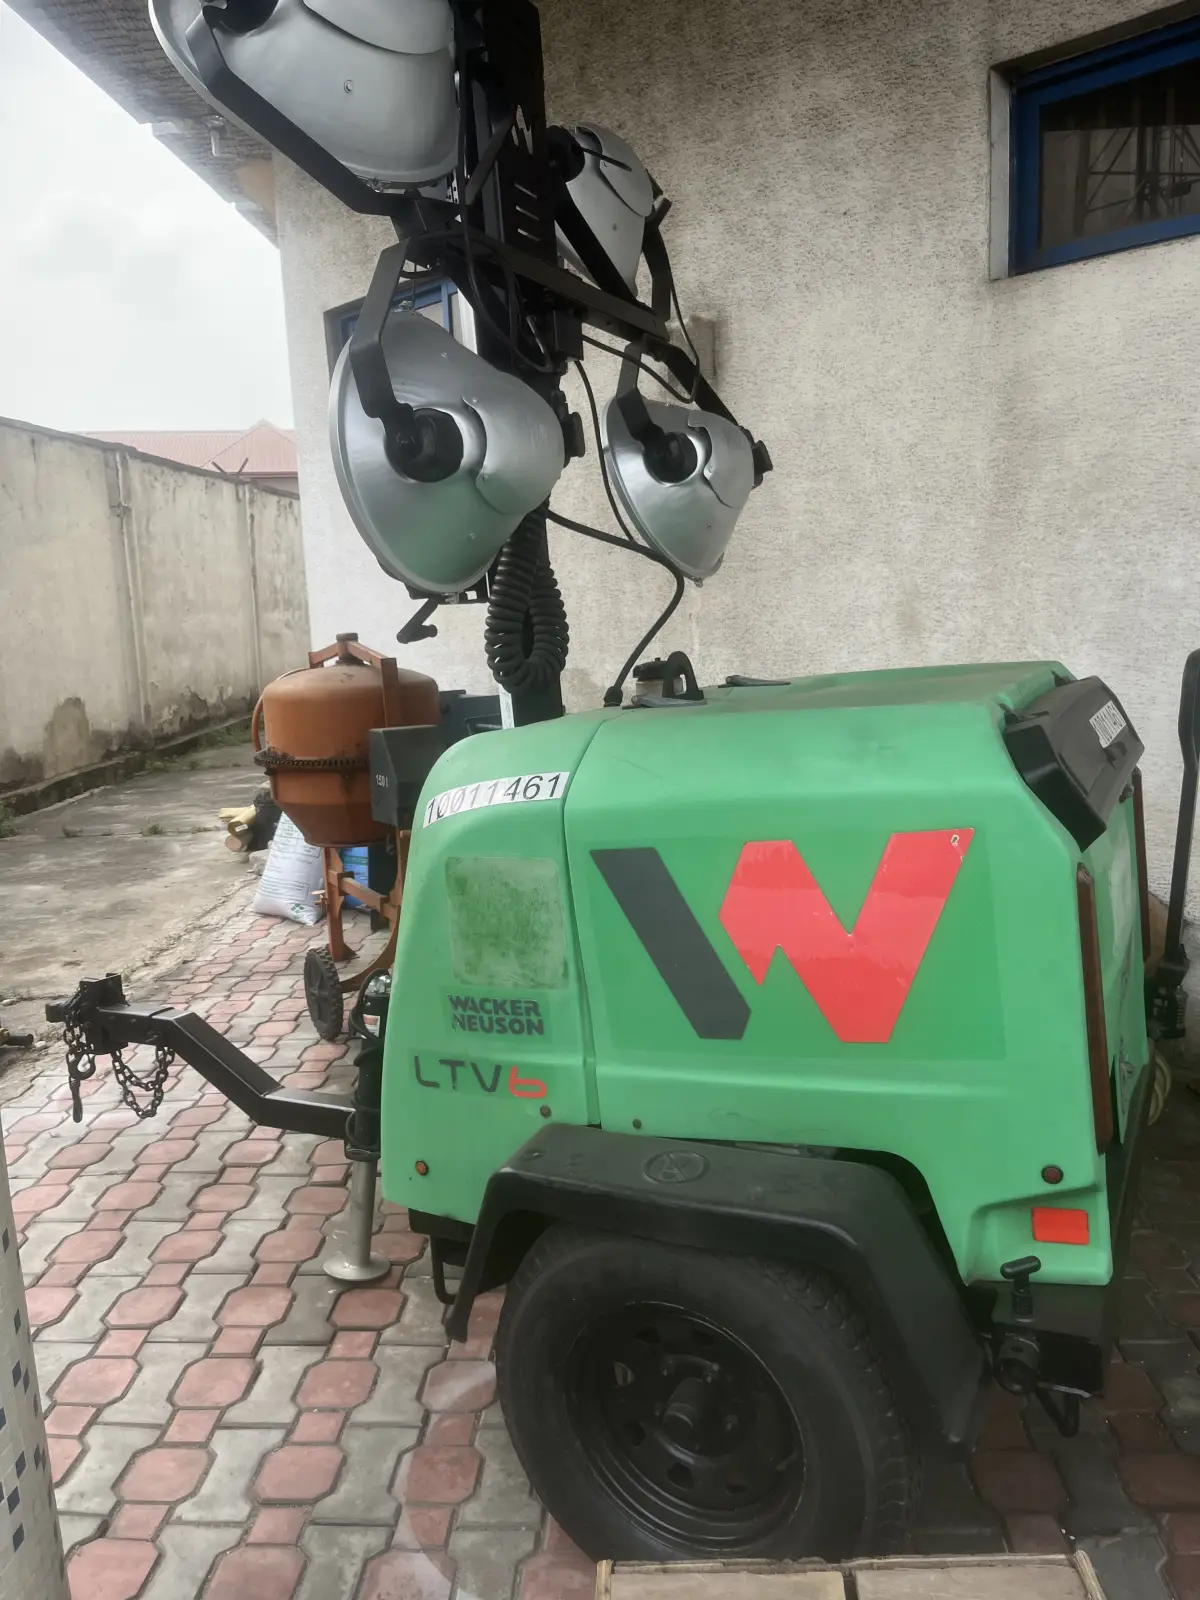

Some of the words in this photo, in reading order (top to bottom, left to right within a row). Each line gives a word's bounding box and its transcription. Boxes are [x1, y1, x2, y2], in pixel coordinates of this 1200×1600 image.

[426, 772, 562, 823] 10011461
[446, 993, 542, 1018] WACKER
[452, 1013, 545, 1035] NEUSON
[414, 1055, 547, 1099] LTV6
